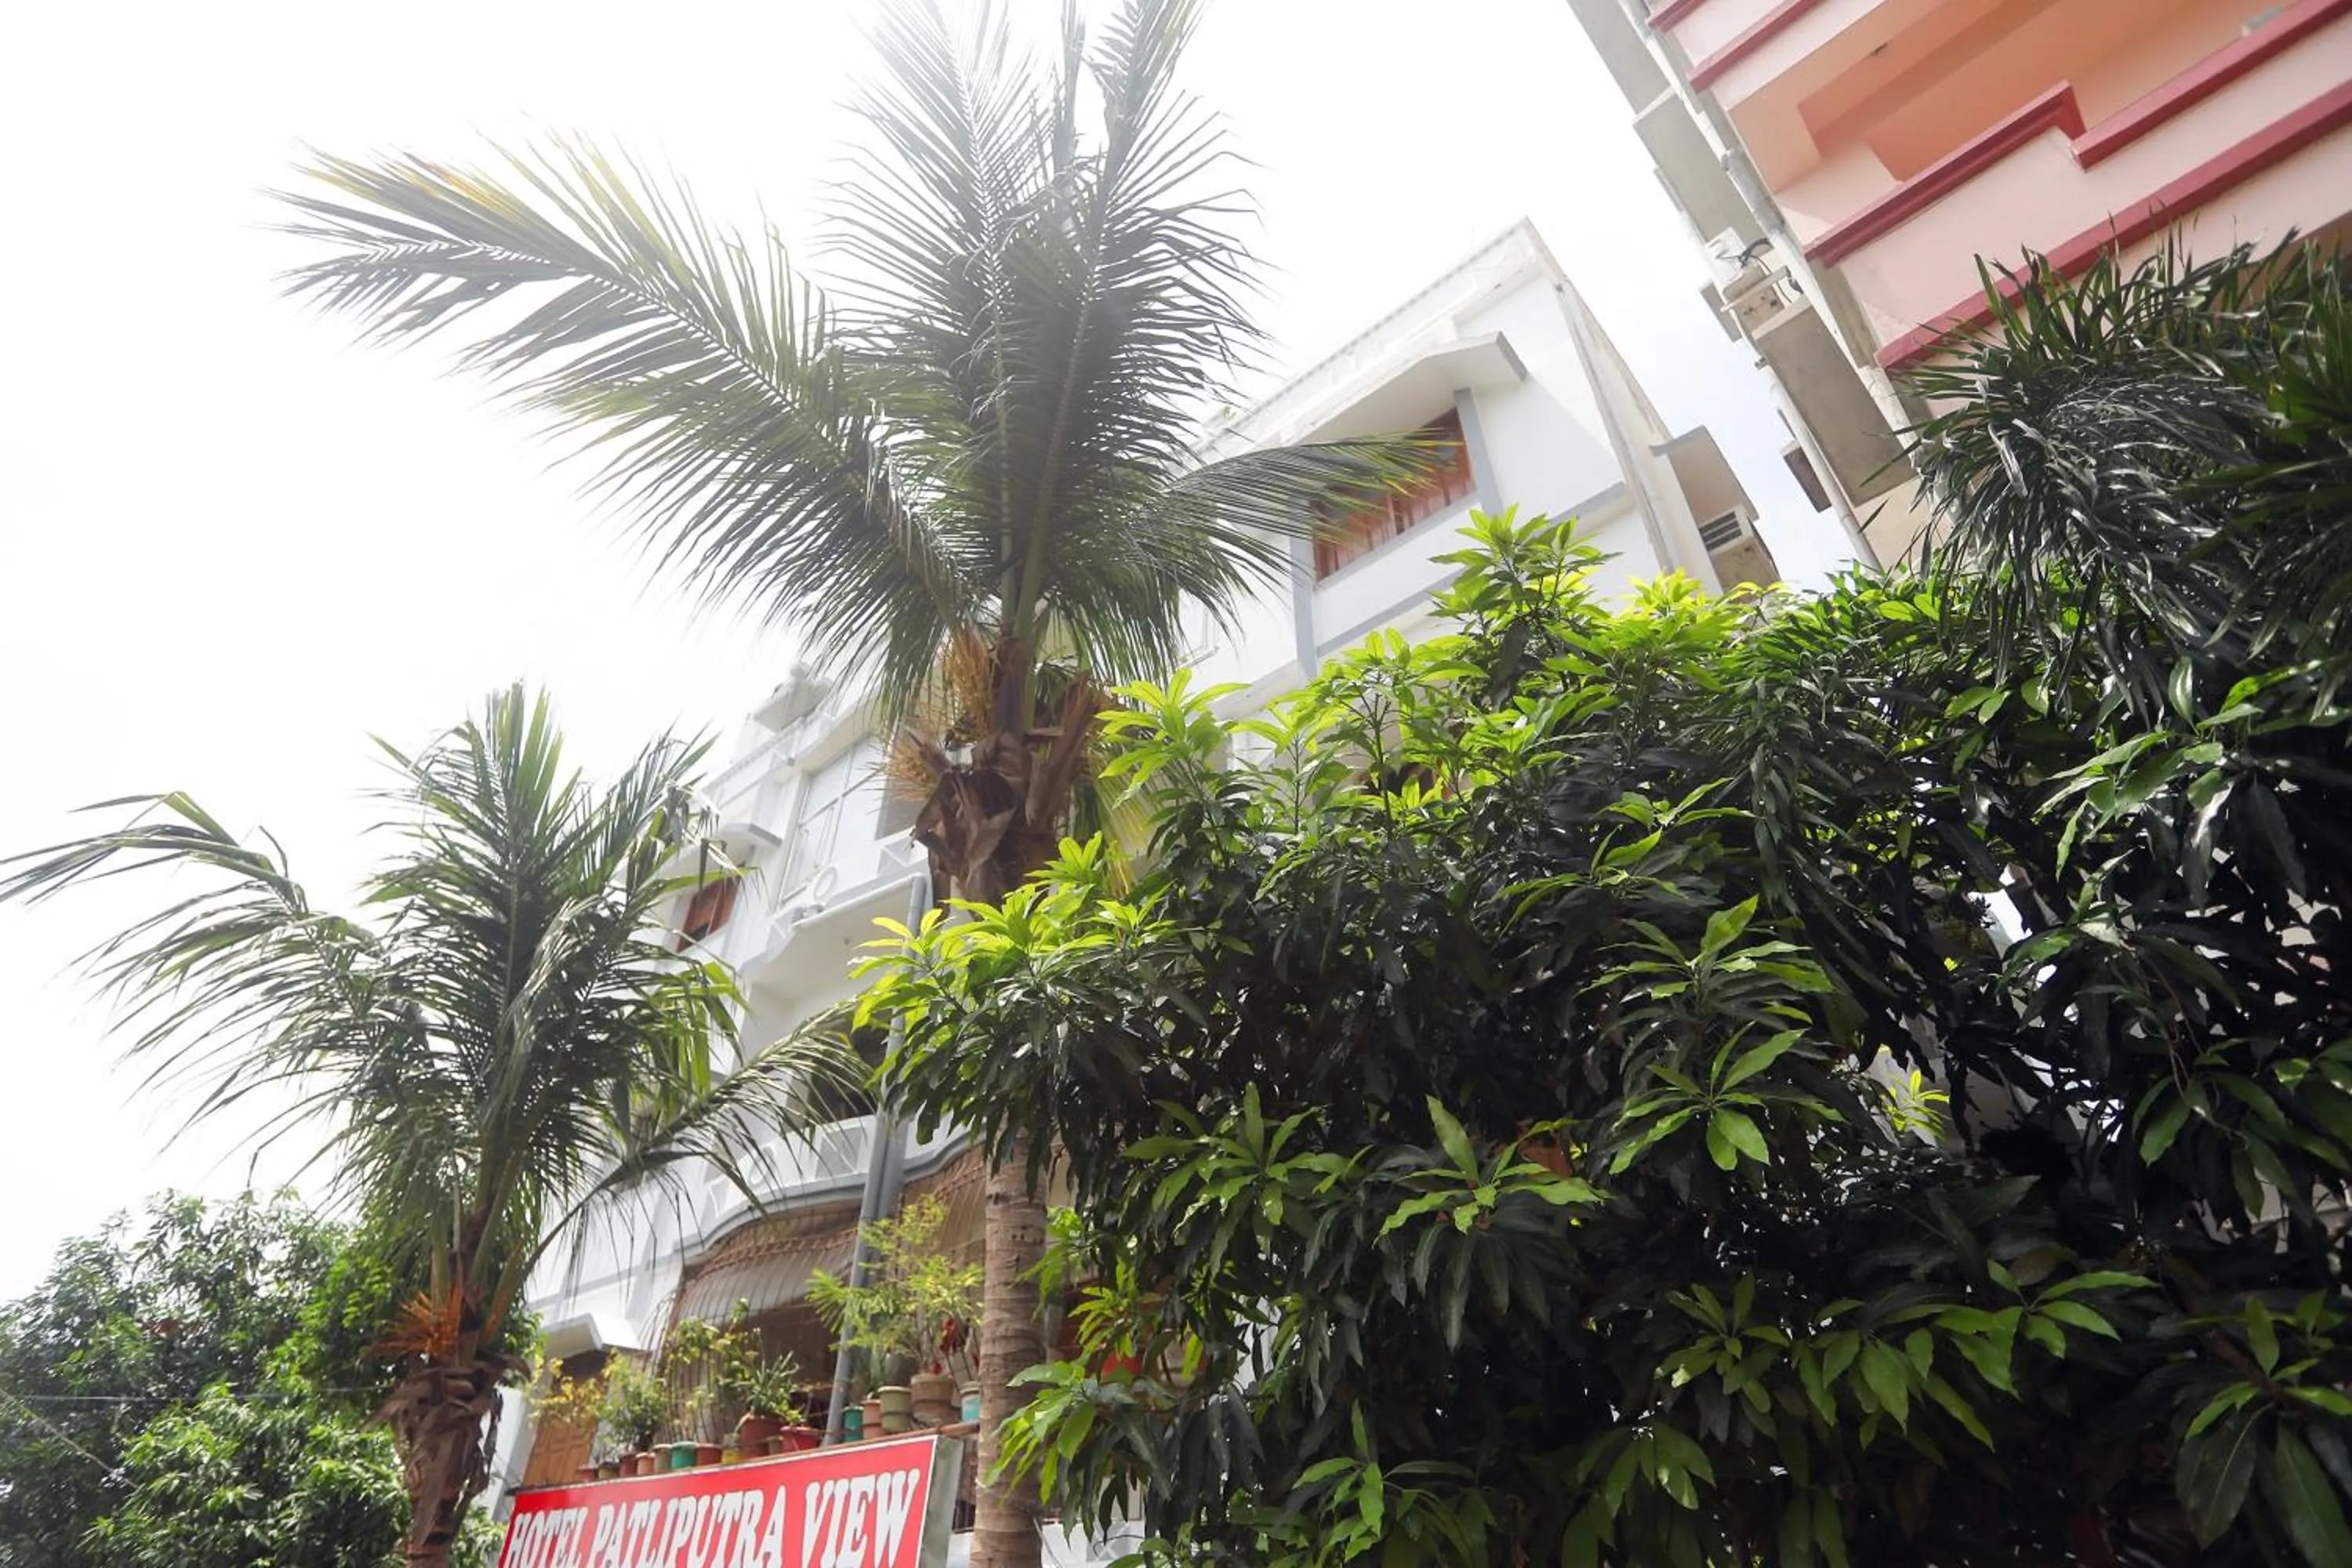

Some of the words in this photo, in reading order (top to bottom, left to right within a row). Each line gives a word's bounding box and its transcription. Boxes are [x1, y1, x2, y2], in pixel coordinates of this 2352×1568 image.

[503, 1506, 588, 1568] HOTEL
[586, 1484, 786, 1568] PATLIPUTRA
[801, 1468, 920, 1568] VIEW
